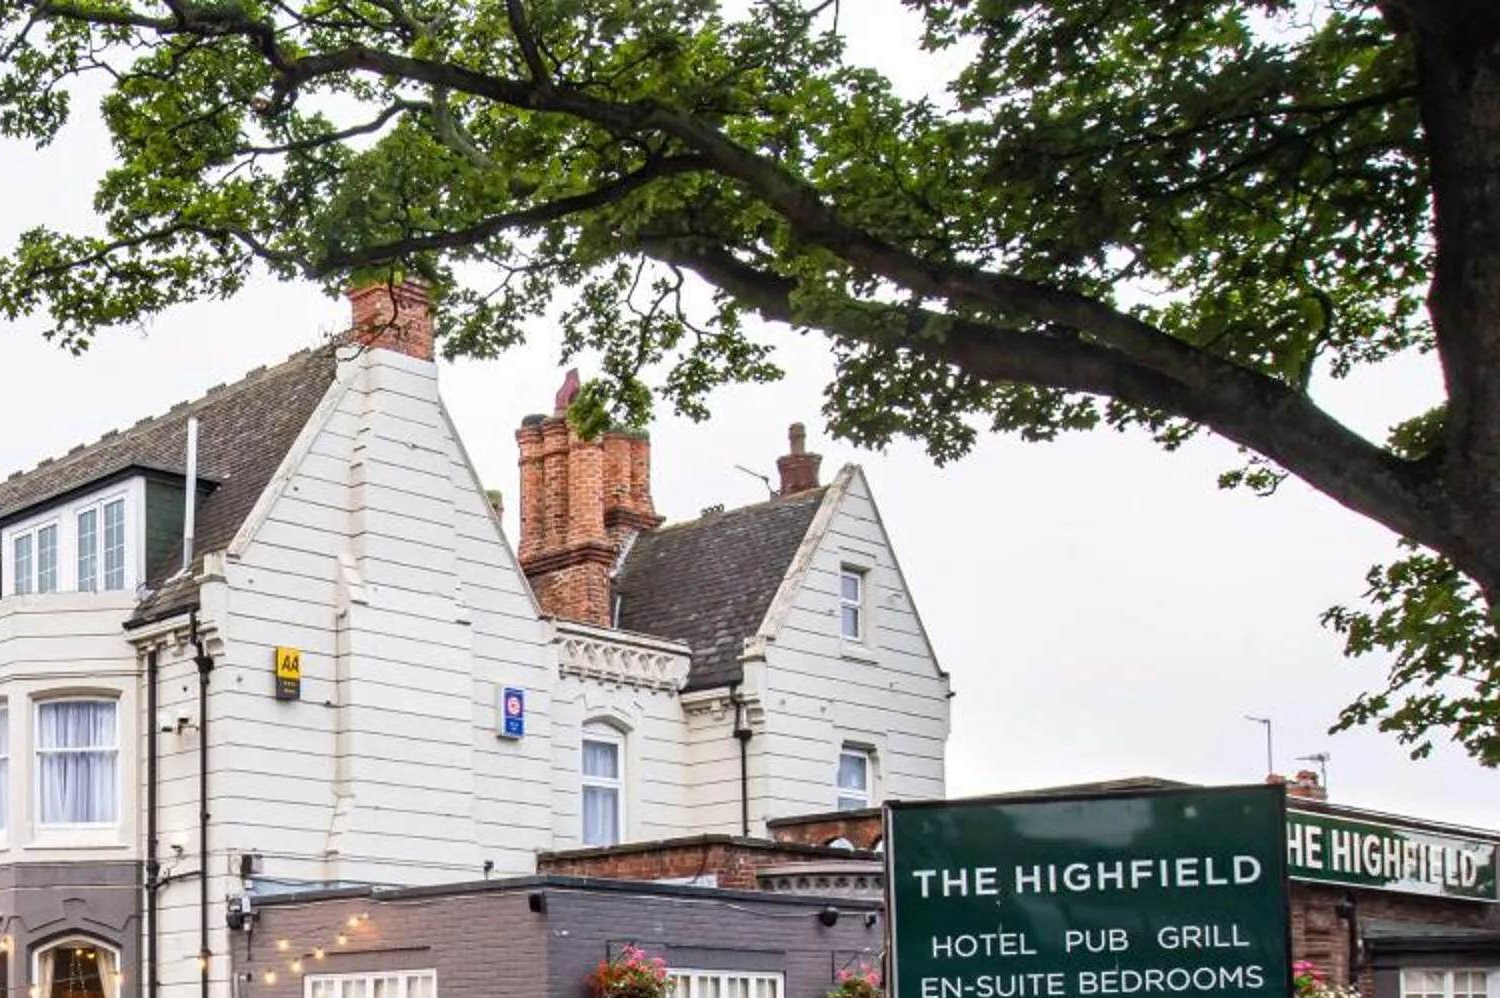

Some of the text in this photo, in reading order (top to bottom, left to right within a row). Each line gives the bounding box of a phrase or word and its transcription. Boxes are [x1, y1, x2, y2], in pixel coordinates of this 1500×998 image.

[1286, 821, 1478, 887] HE HIGHFIELD
[912, 855, 1263, 898] THE HIGHFIELD
[931, 924, 1250, 959] HOTEL PUB GRILL
[1079, 965, 1264, 994] BEDROOMS
